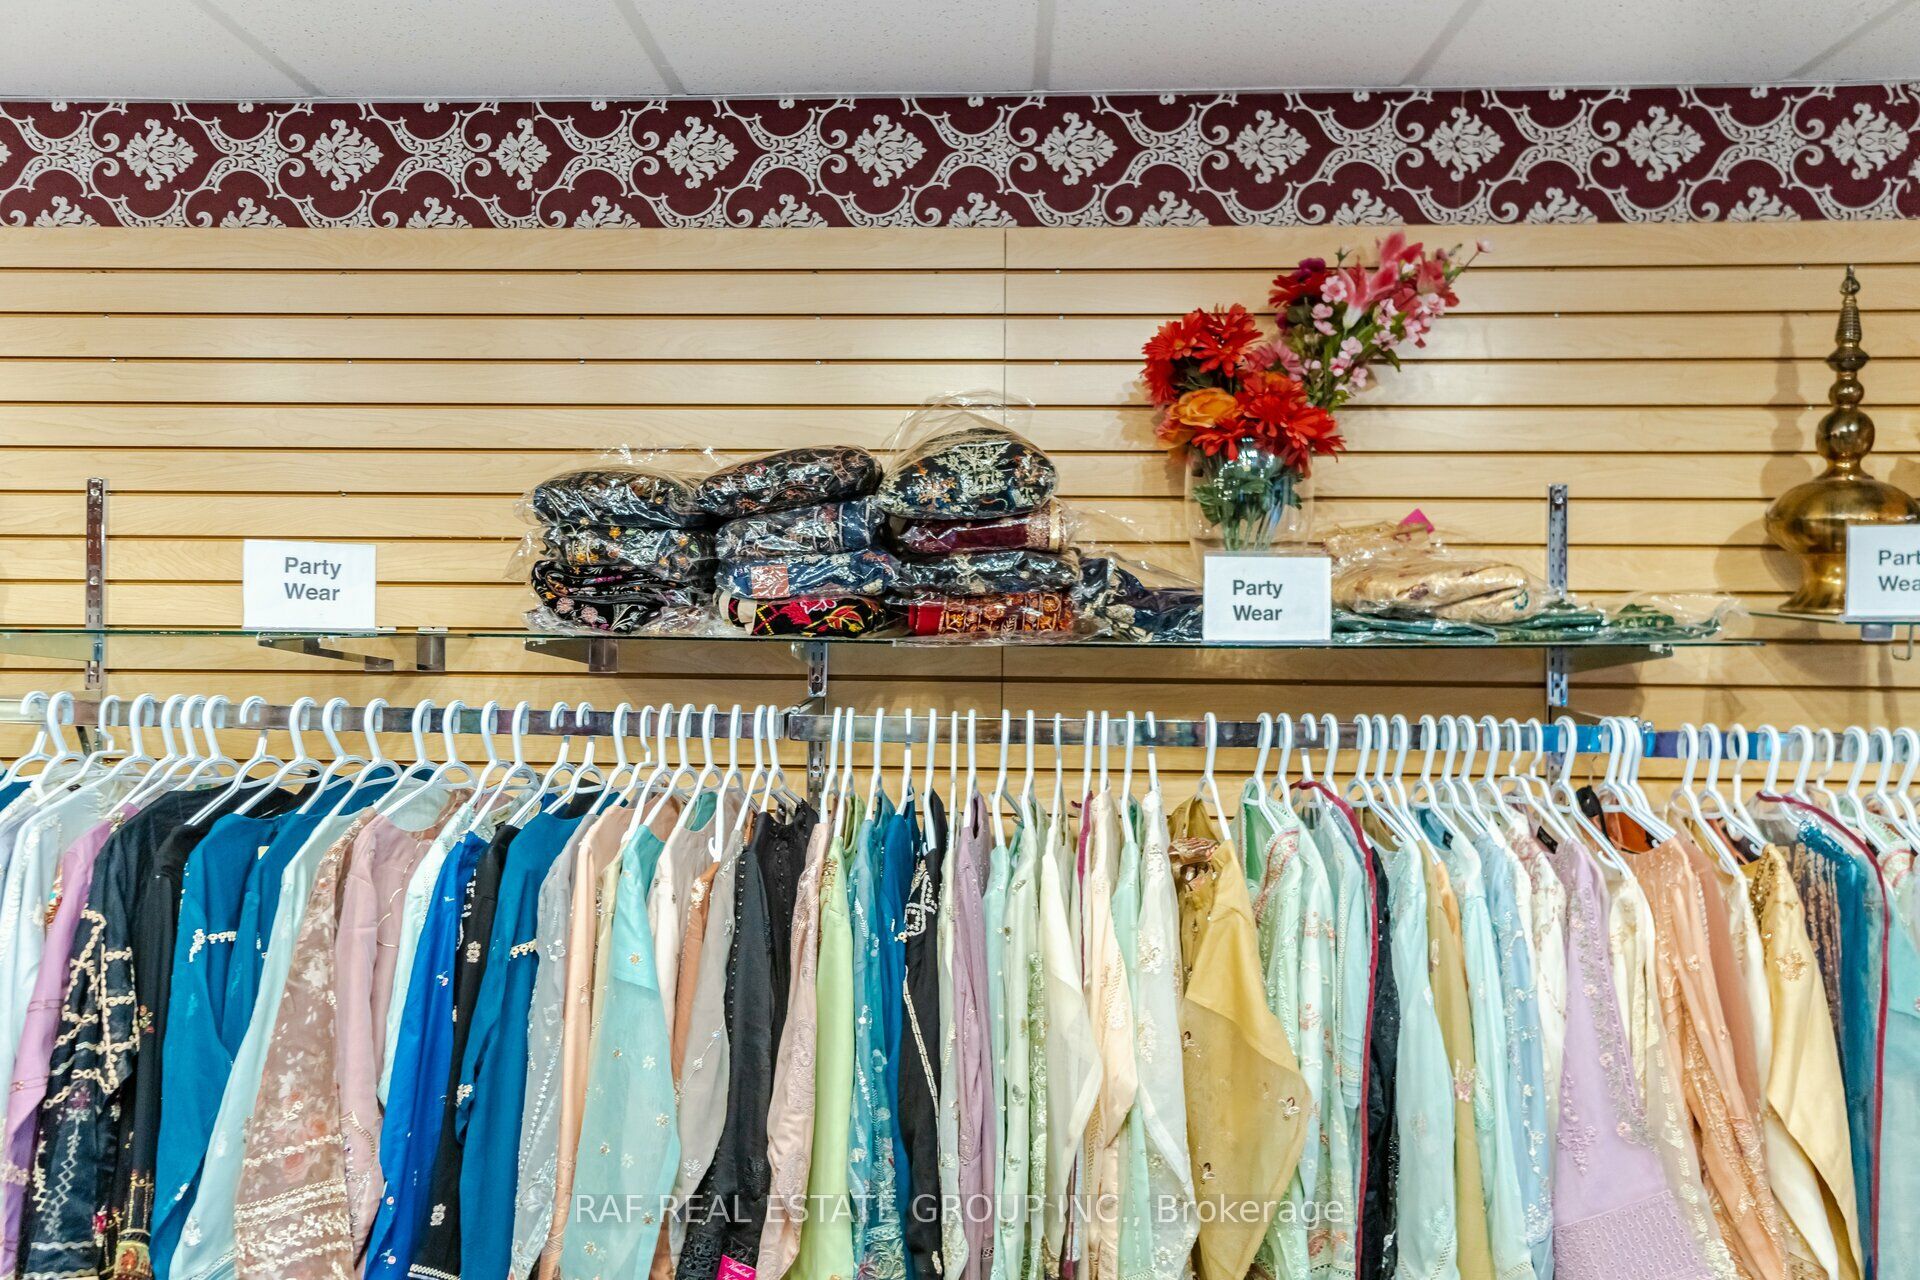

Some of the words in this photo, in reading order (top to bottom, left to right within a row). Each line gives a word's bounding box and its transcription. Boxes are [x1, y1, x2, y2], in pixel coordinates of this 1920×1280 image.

[284, 556, 342, 580] Party
[284, 582, 341, 601] Wear
[1232, 579, 1283, 599] Party
[1878, 575, 1920, 592] Wea
[1232, 604, 1283, 621] Wear
